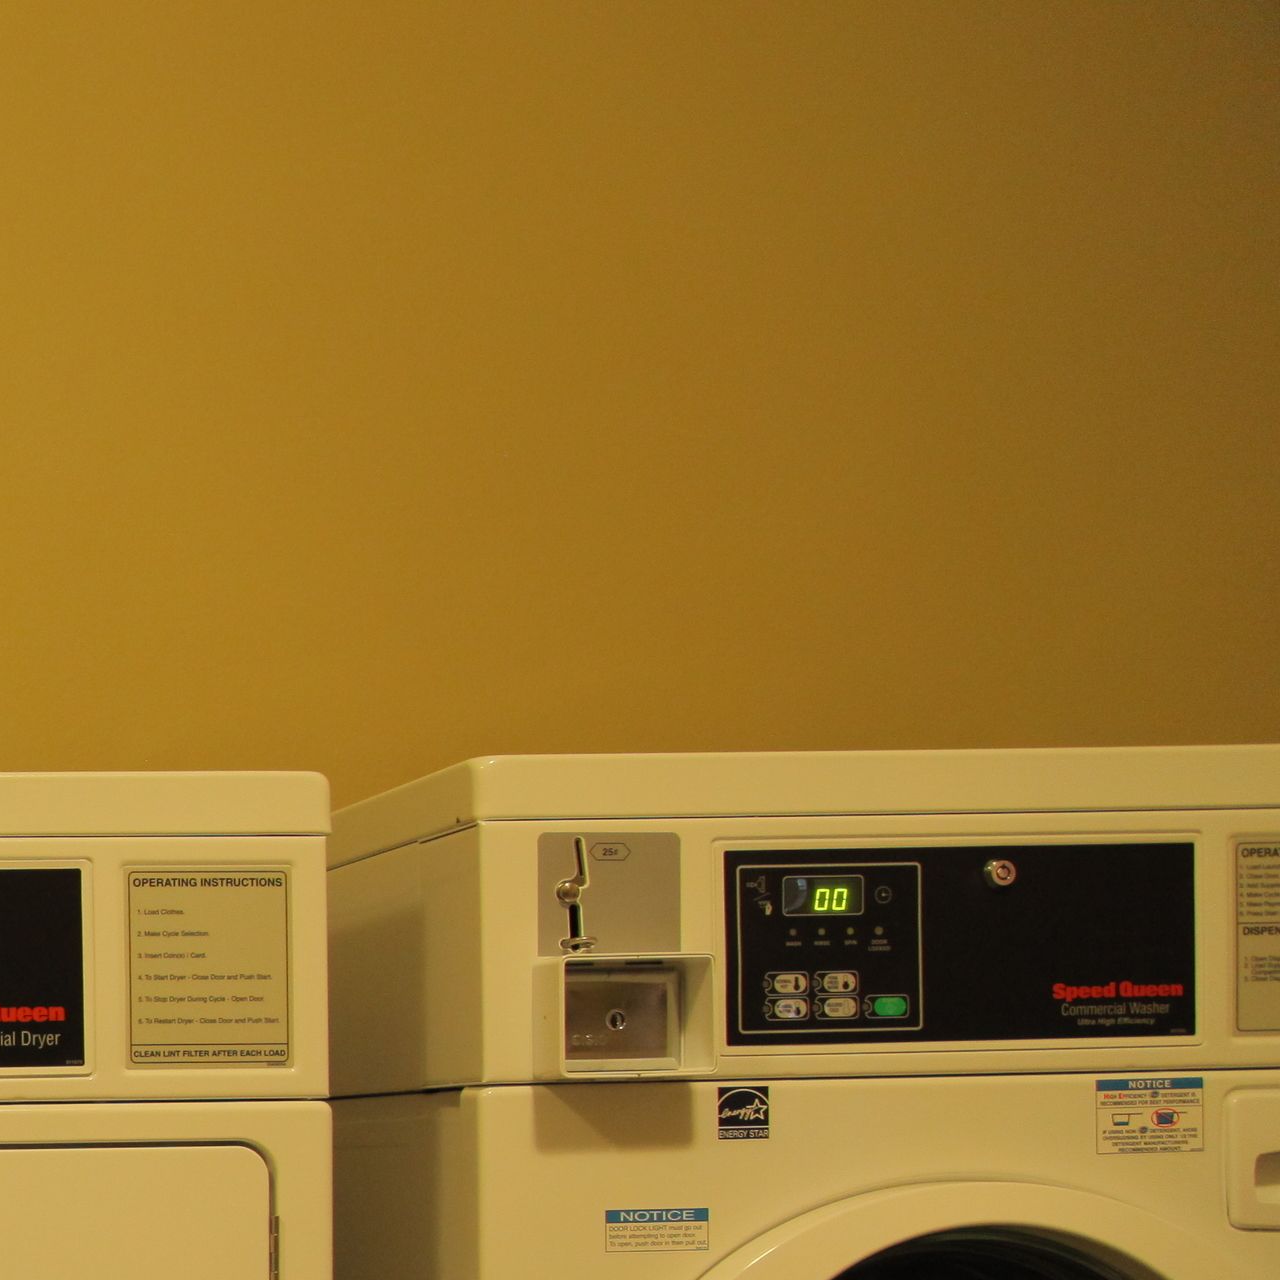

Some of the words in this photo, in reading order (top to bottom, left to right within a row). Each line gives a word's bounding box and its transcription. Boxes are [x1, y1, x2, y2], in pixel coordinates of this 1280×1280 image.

[133, 878, 197, 887] OPERATING
[200, 878, 282, 887] INSTRUCTIONS
[814, 888, 848, 910] 00
[1052, 982, 1116, 1002] Speed
[1119, 980, 1183, 997] Queen
[1061, 1002, 1125, 1016] Commercial
[1129, 1001, 1170, 1014] Washer
[21, 1031, 60, 1049] Dryer
[1128, 1080, 1171, 1088] NOTICE
[719, 1130, 747, 1138] ENERGY
[749, 1129, 768, 1138] STAR
[620, 1210, 695, 1222] NOTICE
